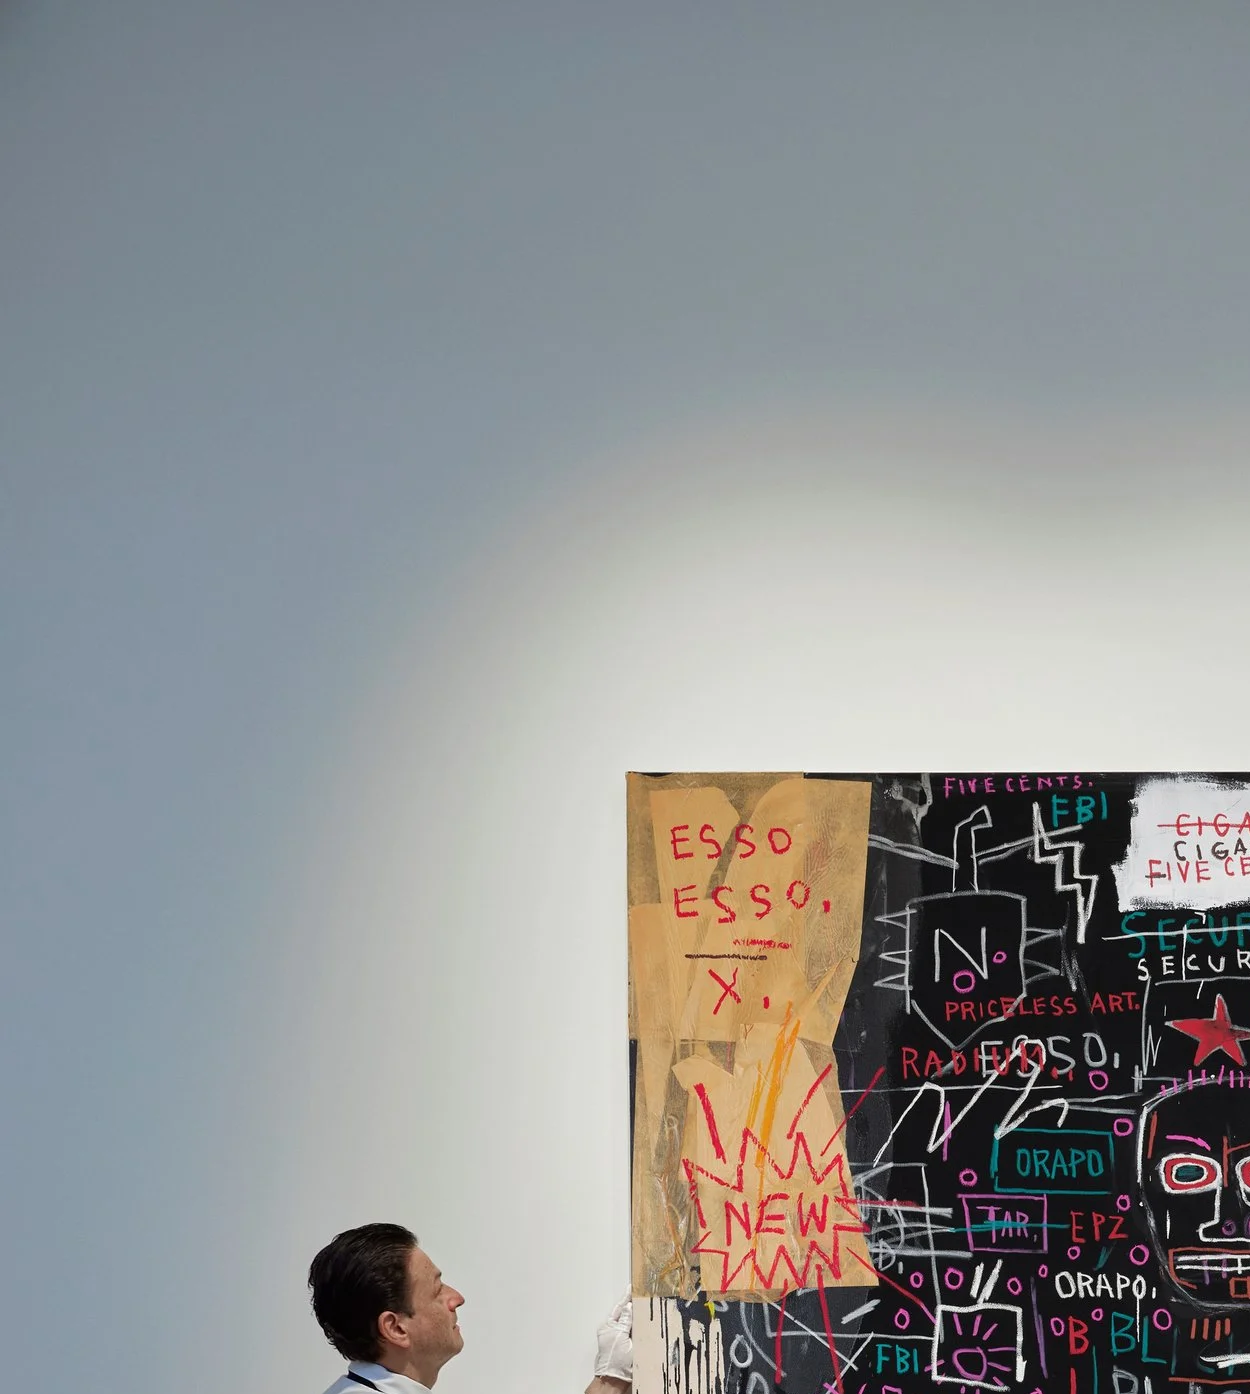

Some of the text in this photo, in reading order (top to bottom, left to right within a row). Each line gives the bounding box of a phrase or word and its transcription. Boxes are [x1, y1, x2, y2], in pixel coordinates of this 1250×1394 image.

[943, 776, 995, 799] FIVE
[1051, 792, 1108, 828] FBI
[669, 823, 793, 861] ESSO
[1147, 858, 1212, 888] FIVE
[672, 879, 832, 925] ESSO.
[944, 995, 1079, 1023] PRICELESS
[1015, 1147, 1105, 1180] ORAPO
[724, 1192, 830, 1247] NEW
[1069, 1210, 1129, 1244] EPZ
[875, 1342, 920, 1375] FBI
